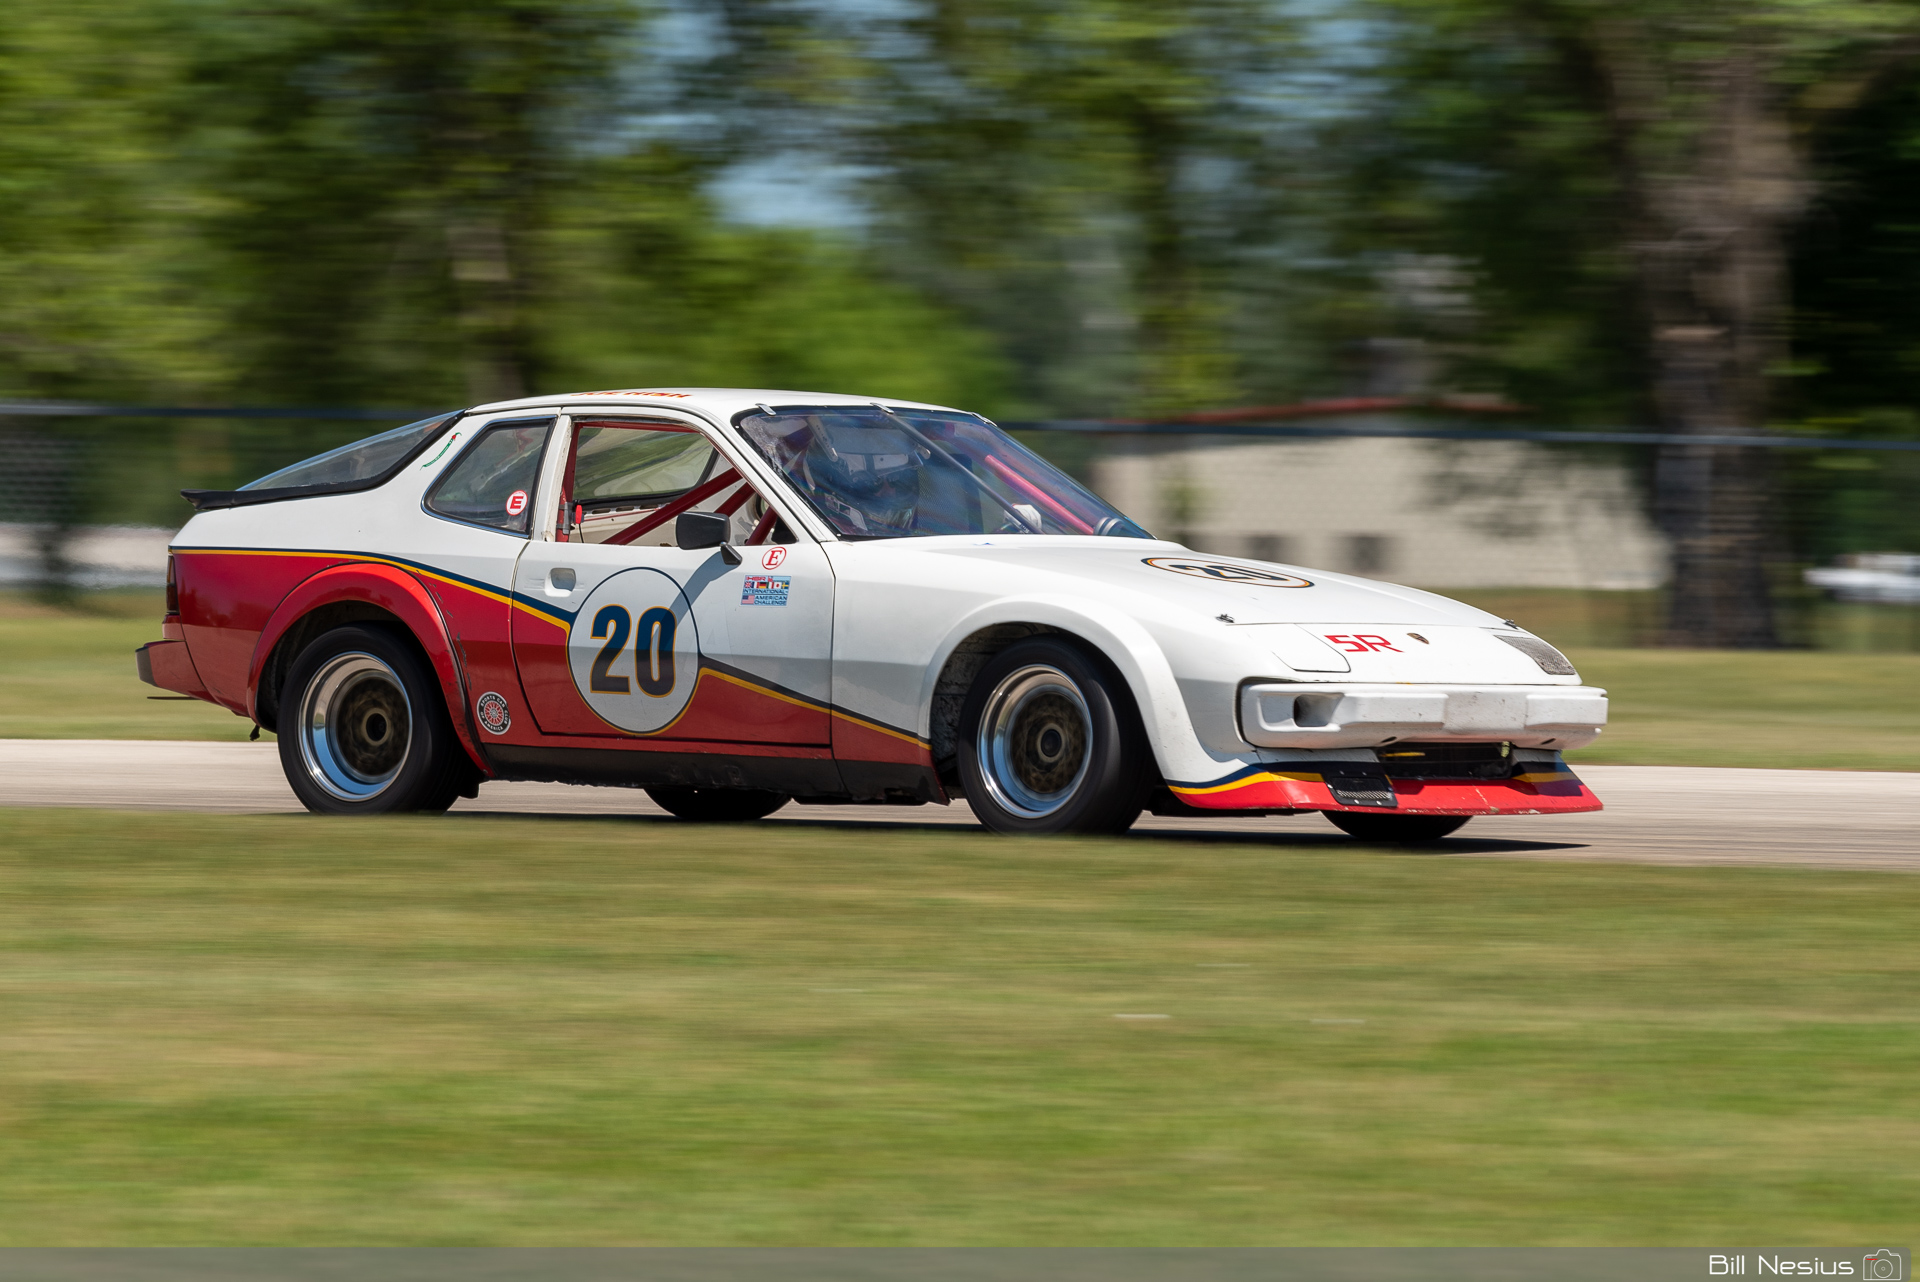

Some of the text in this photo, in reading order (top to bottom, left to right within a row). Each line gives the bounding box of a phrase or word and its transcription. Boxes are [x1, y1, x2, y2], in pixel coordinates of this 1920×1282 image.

[510, 496, 524, 509] E
[766, 550, 782, 565] E
[1168, 565, 1290, 581] 20
[590, 604, 677, 698] 20
[480, 696, 496, 706] SPORTS
[496, 698, 505, 708] CAR
[484, 721, 503, 730] AMERICA
